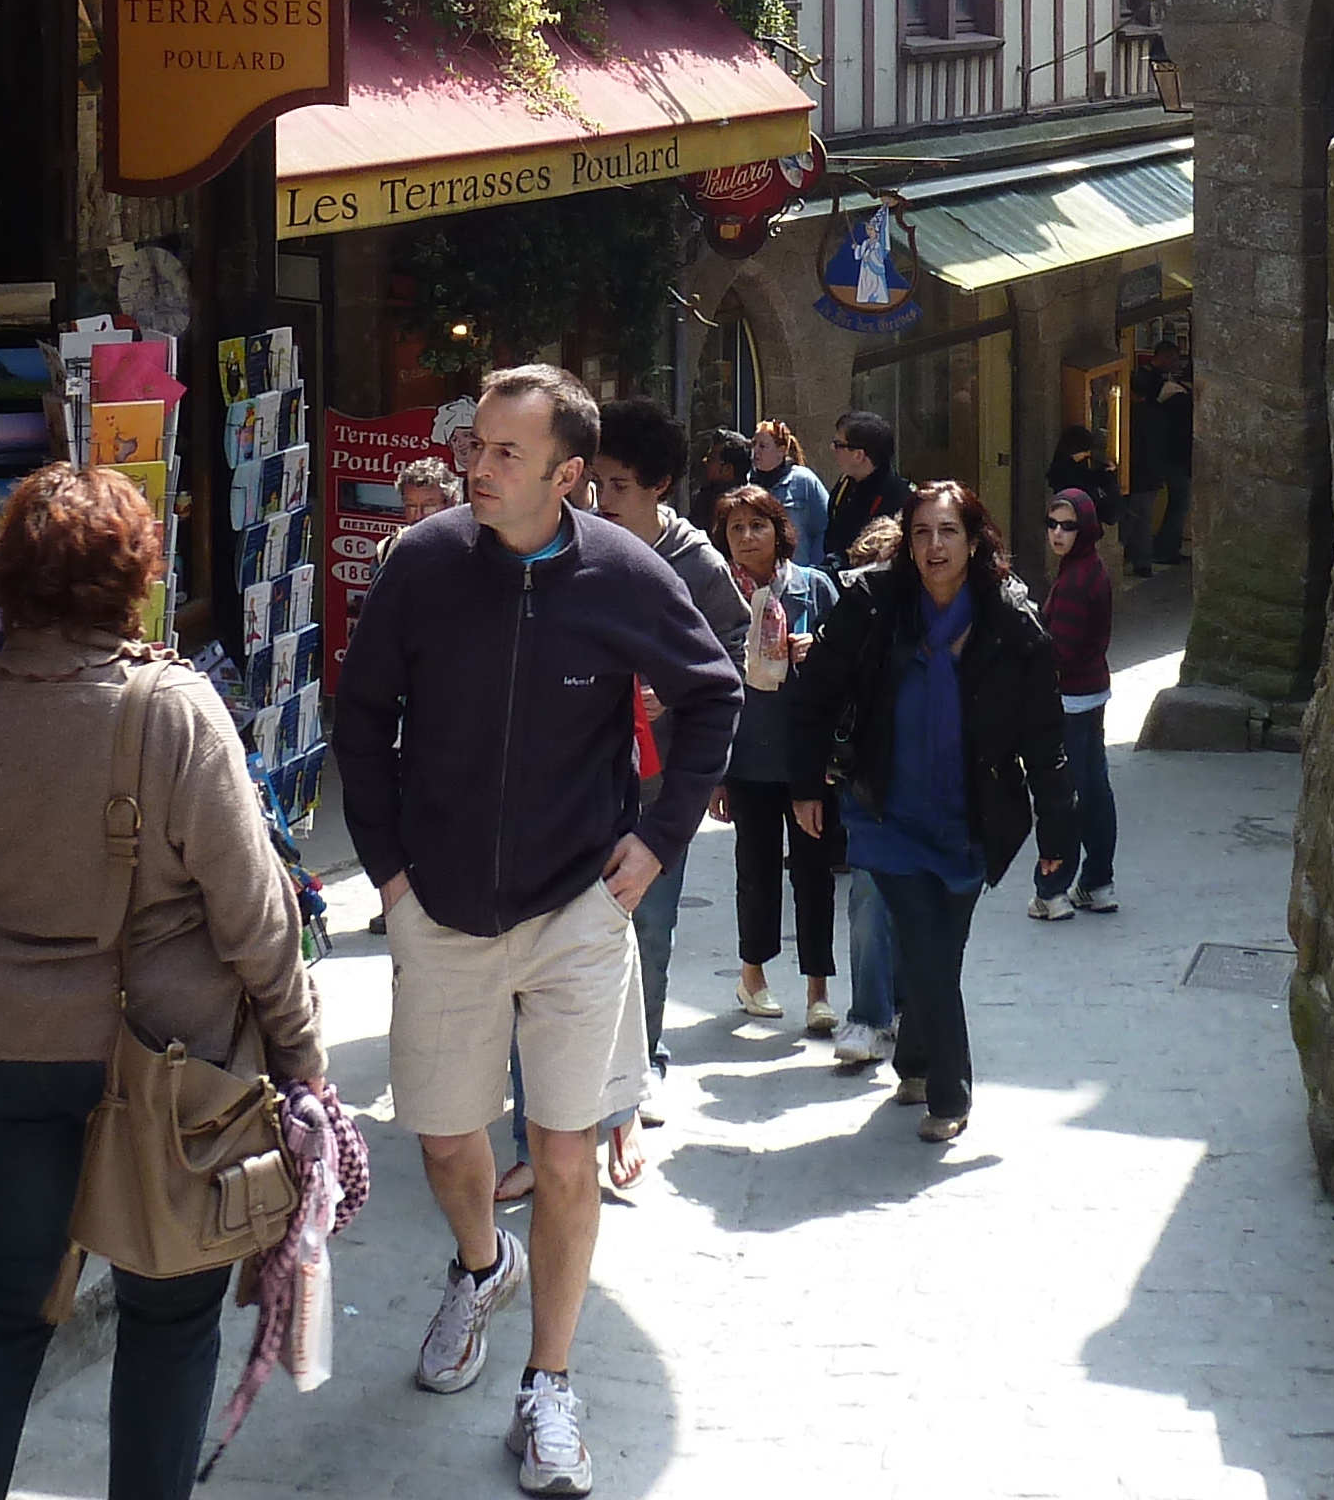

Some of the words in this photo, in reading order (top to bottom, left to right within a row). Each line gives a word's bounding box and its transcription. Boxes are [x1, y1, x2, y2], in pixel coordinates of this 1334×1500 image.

[164, 50, 285, 71] POULARD
[286, 188, 359, 228] Les
[381, 161, 551, 215] Terrasses
[572, 136, 681, 186] Poulard
[334, 425, 430, 450] Terrasses
[330, 450, 408, 474] Poula
[343, 520, 405, 534] RESTAUR
